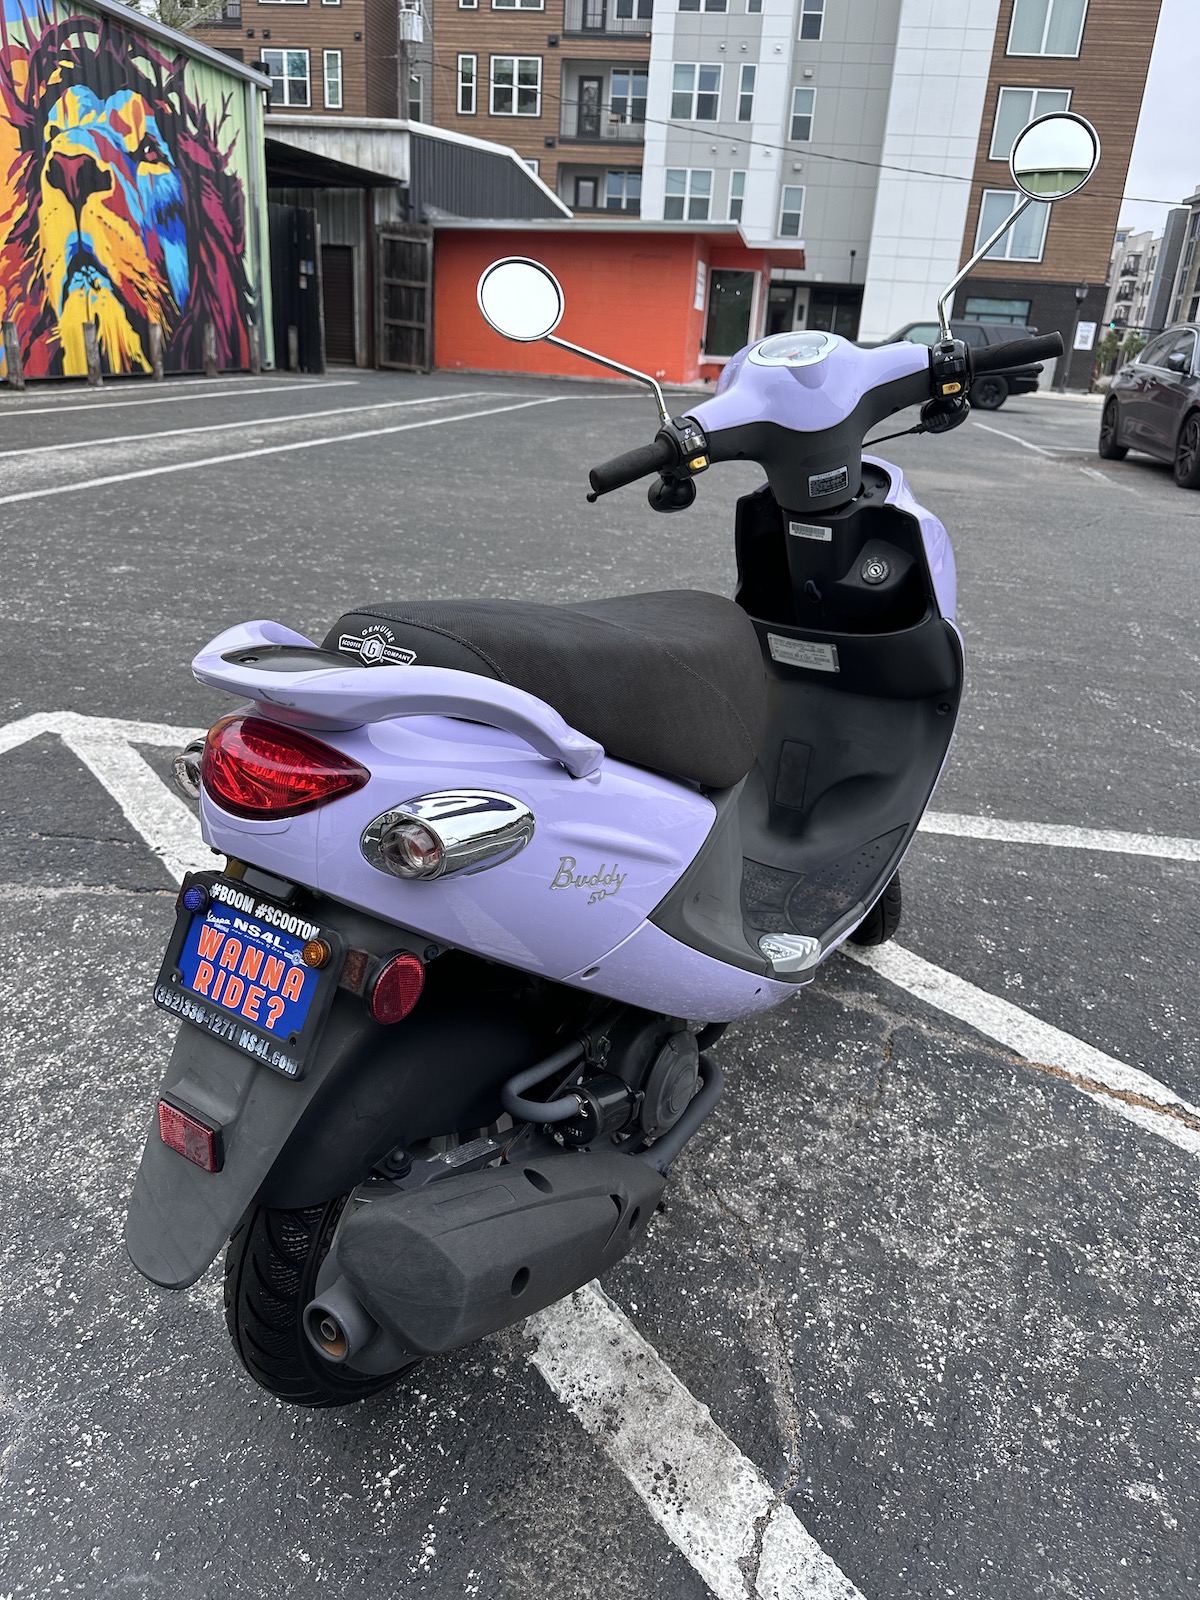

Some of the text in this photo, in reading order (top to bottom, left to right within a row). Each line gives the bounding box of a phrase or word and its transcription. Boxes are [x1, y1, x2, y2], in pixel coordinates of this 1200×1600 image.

[342, 639, 361, 648] SCOOTER
[384, 649, 411, 661] COMPANY
[361, 625, 395, 642] GENUINE
[549, 856, 627, 895] Buddy
[209, 883, 255, 914] #BOOM
[587, 889, 606, 905] 50
[233, 917, 286, 950] NS4L
[197, 924, 305, 1002] WANNA
[193, 960, 285, 1029] RIDE?
[155, 985, 237, 1041] (352)336-1271
